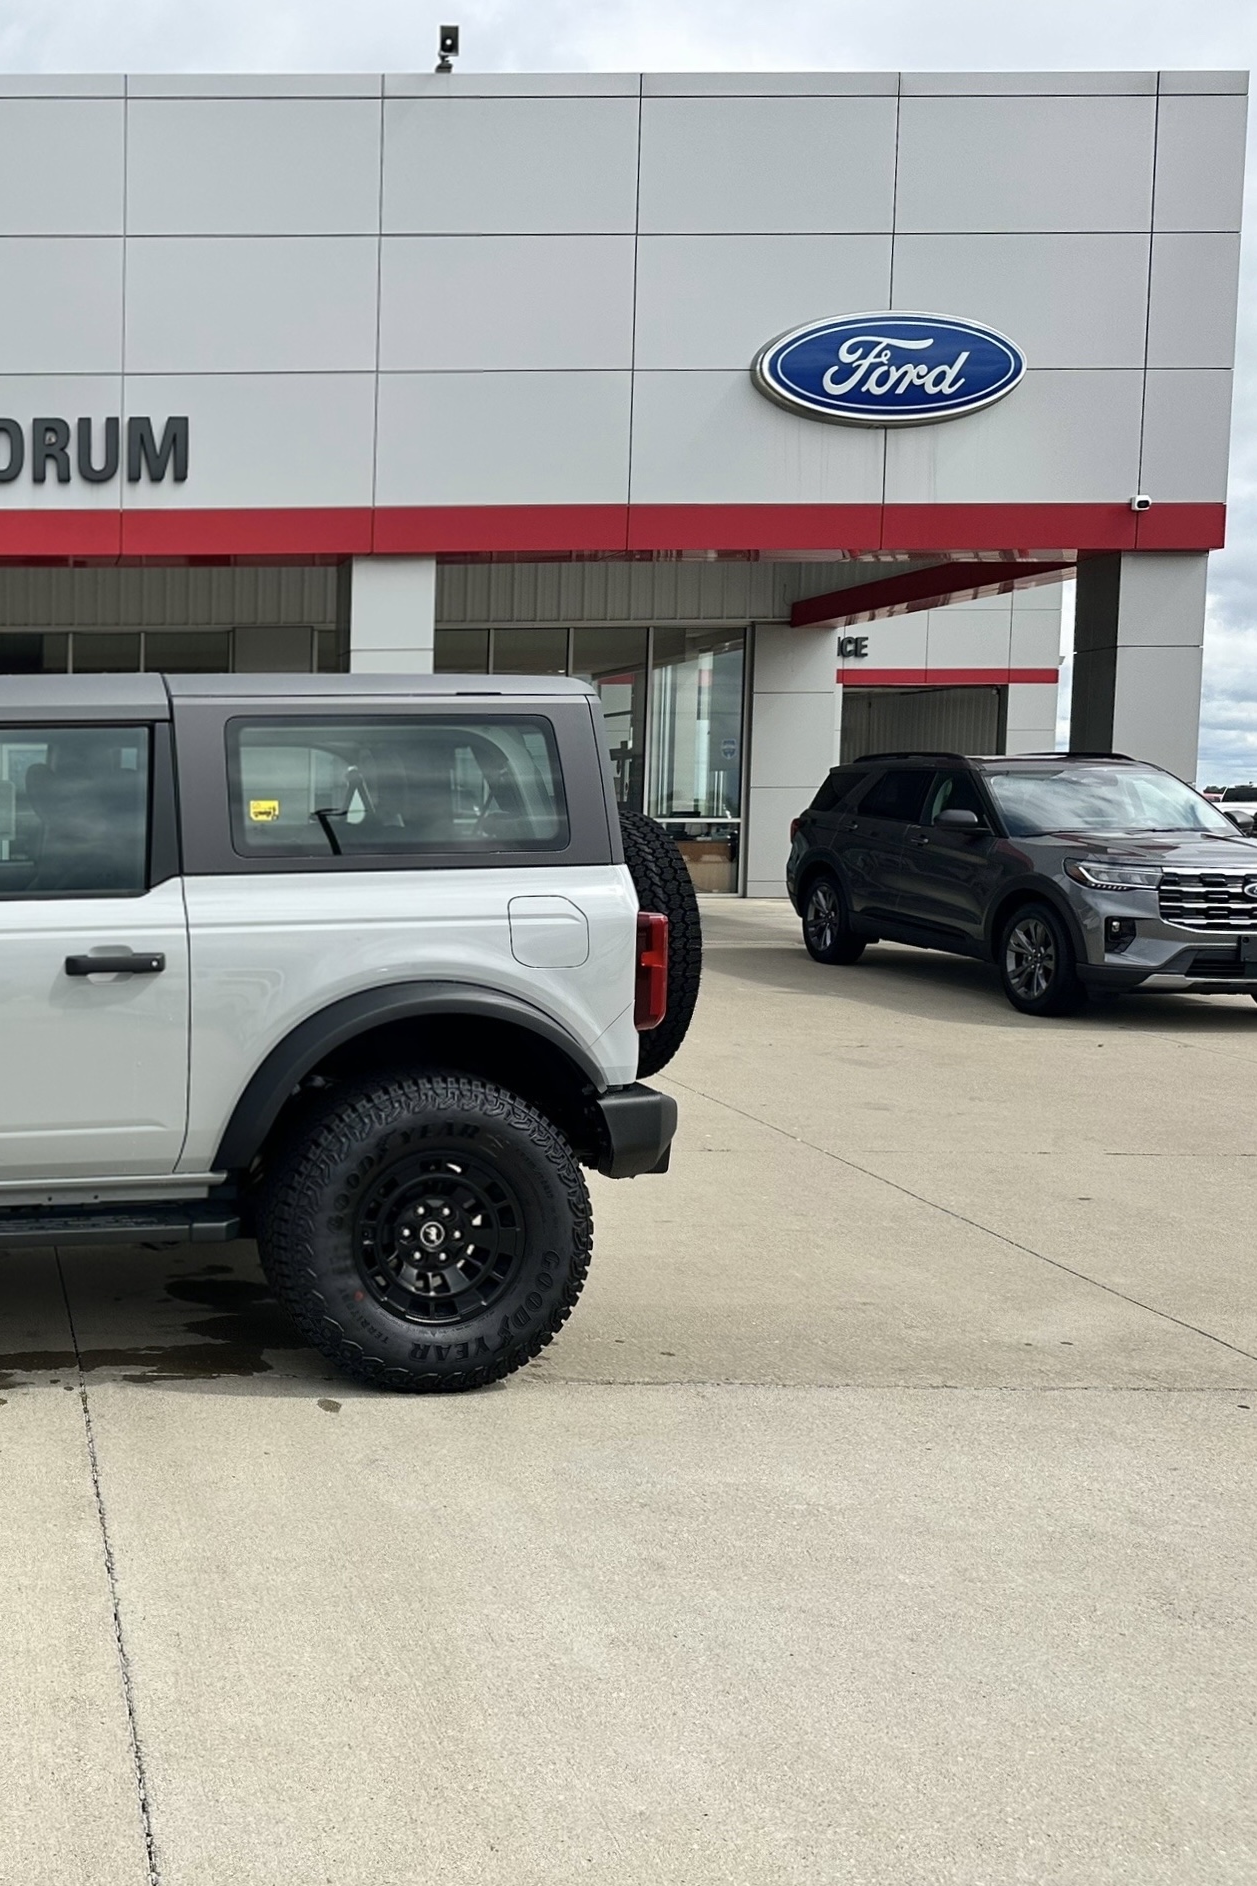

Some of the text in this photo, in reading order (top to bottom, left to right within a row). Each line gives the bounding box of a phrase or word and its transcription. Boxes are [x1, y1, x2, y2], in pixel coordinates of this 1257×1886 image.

[823, 336, 970, 395] Ford
[837, 636, 869, 658] ICE
[409, 1249, 561, 1365] GOODYEAR
